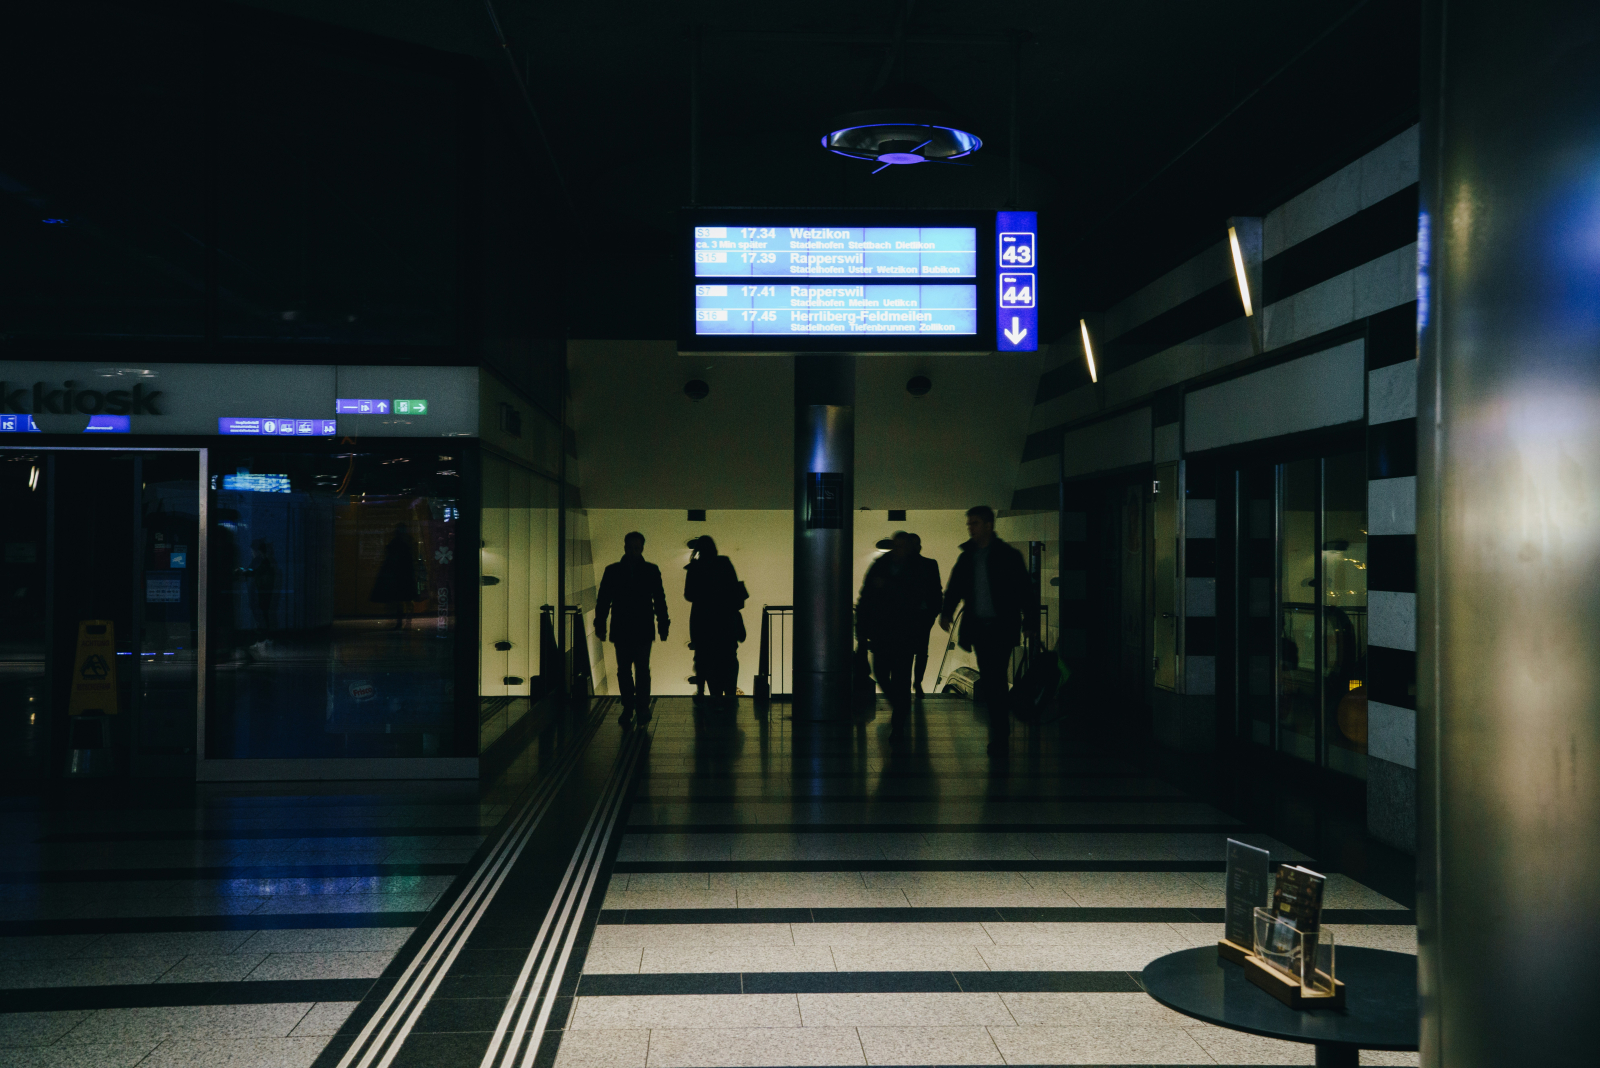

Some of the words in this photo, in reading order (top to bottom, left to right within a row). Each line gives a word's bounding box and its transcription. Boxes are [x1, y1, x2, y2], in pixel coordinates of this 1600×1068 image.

[697, 228, 711, 237] S3
[741, 228, 776, 239] 17.34
[790, 228, 850, 239] Wetzikon
[738, 241, 767, 250] später
[790, 241, 844, 249] Stadelhofen
[849, 241, 891, 249] Stettbach
[896, 241, 935, 249] Dietlikon
[697, 253, 717, 262] S15
[741, 253, 776, 263] 17.39
[791, 253, 863, 266] Rapperswil
[1003, 246, 1031, 264] 43
[697, 286, 711, 296] S7
[742, 286, 774, 296] 17.41
[791, 286, 863, 299] Rapperswil
[1003, 287, 1032, 304] 44
[698, 311, 718, 320] S16
[742, 311, 777, 321] 17.45
[791, 311, 932, 323] Herrliberg-Feldmeilen
[849, 323, 915, 331] Tiefenbrunnen
[920, 323, 955, 331] Zollikon
[0, 381, 30, 415] k
[33, 380, 163, 415] kiosk
[353, 687, 373, 697] Frisco
